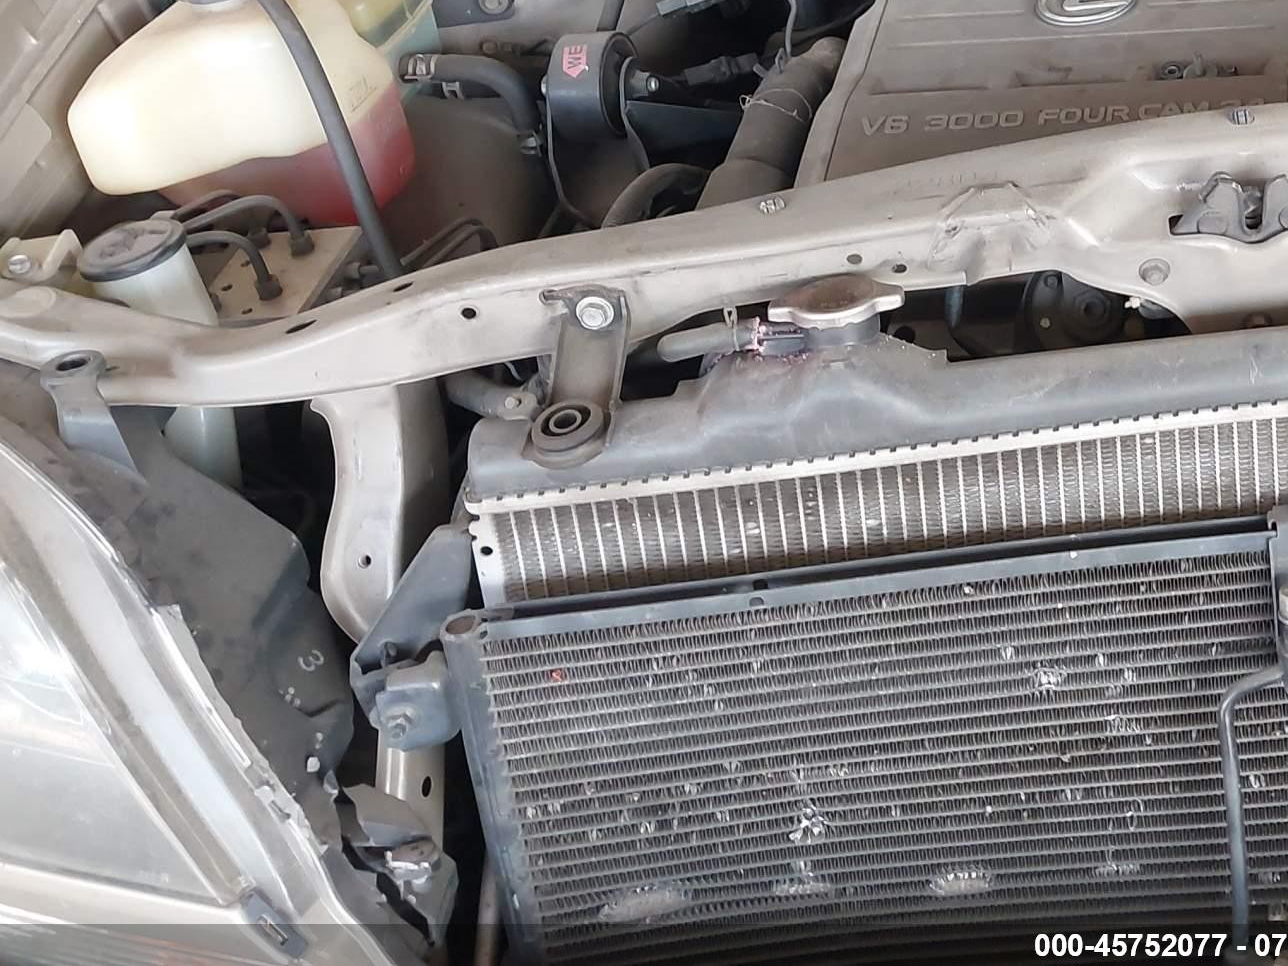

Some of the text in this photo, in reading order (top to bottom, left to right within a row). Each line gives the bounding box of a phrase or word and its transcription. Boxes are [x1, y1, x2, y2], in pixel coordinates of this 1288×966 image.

[862, 115, 910, 136] V6
[924, 110, 1024, 131] 3000
[1038, 104, 1130, 126] FOUR
